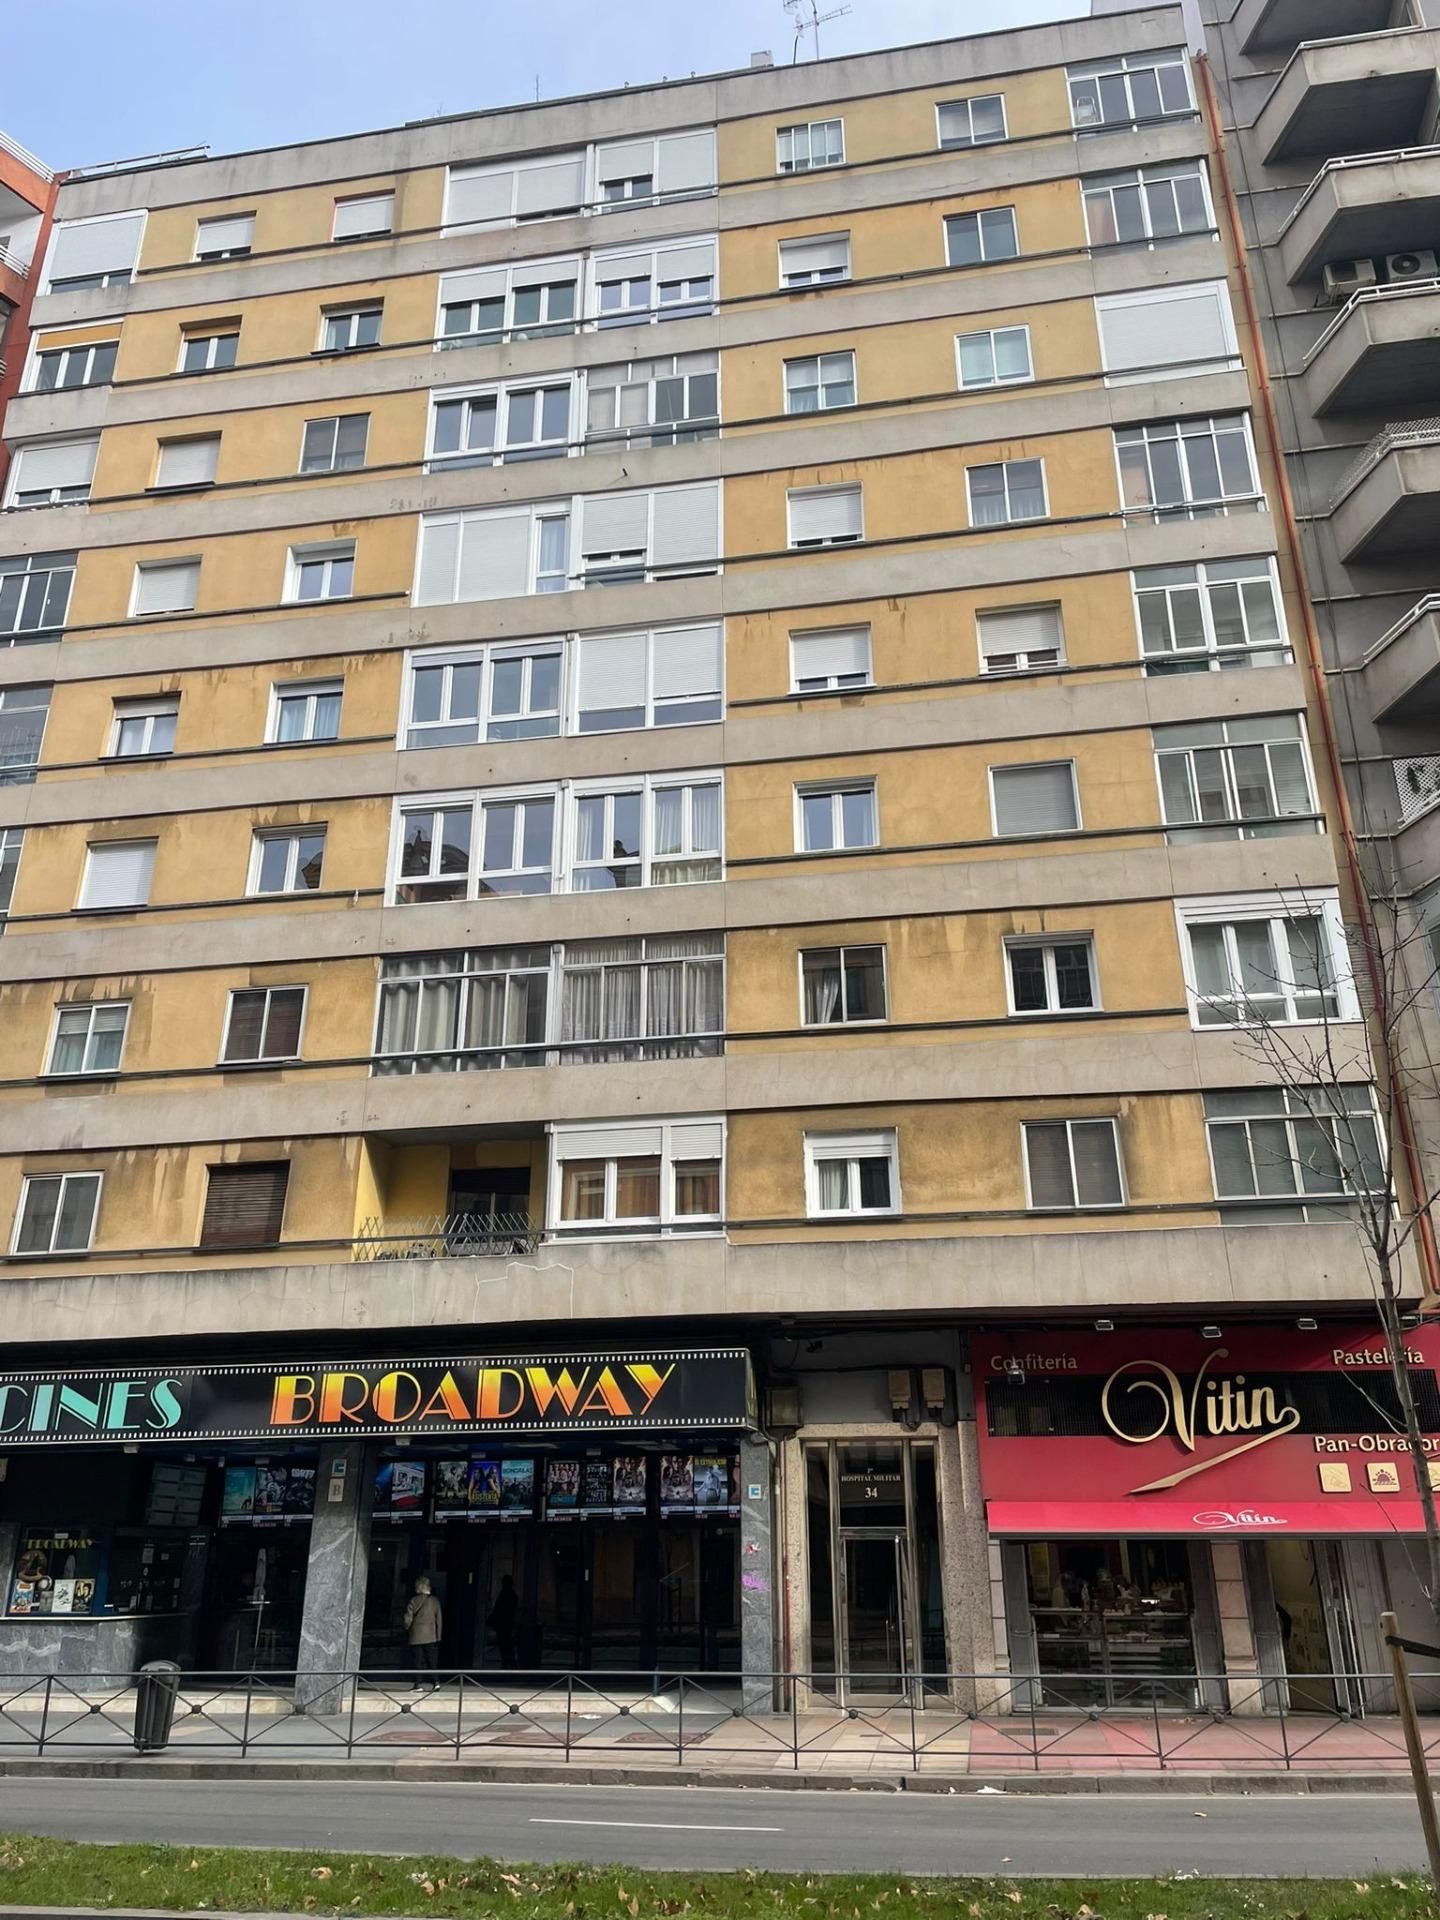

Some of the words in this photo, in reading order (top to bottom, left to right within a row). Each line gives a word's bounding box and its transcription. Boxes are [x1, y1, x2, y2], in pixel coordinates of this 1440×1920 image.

[990, 1353, 1078, 1371] Confitería
[1333, 1346, 1425, 1366] Pastelía
[0, 1379, 183, 1433] CINES
[270, 1364, 676, 1425] BROADWAY
[1314, 1434, 1440, 1453] Pan-Obraor
[865, 1487, 878, 1498] 34
